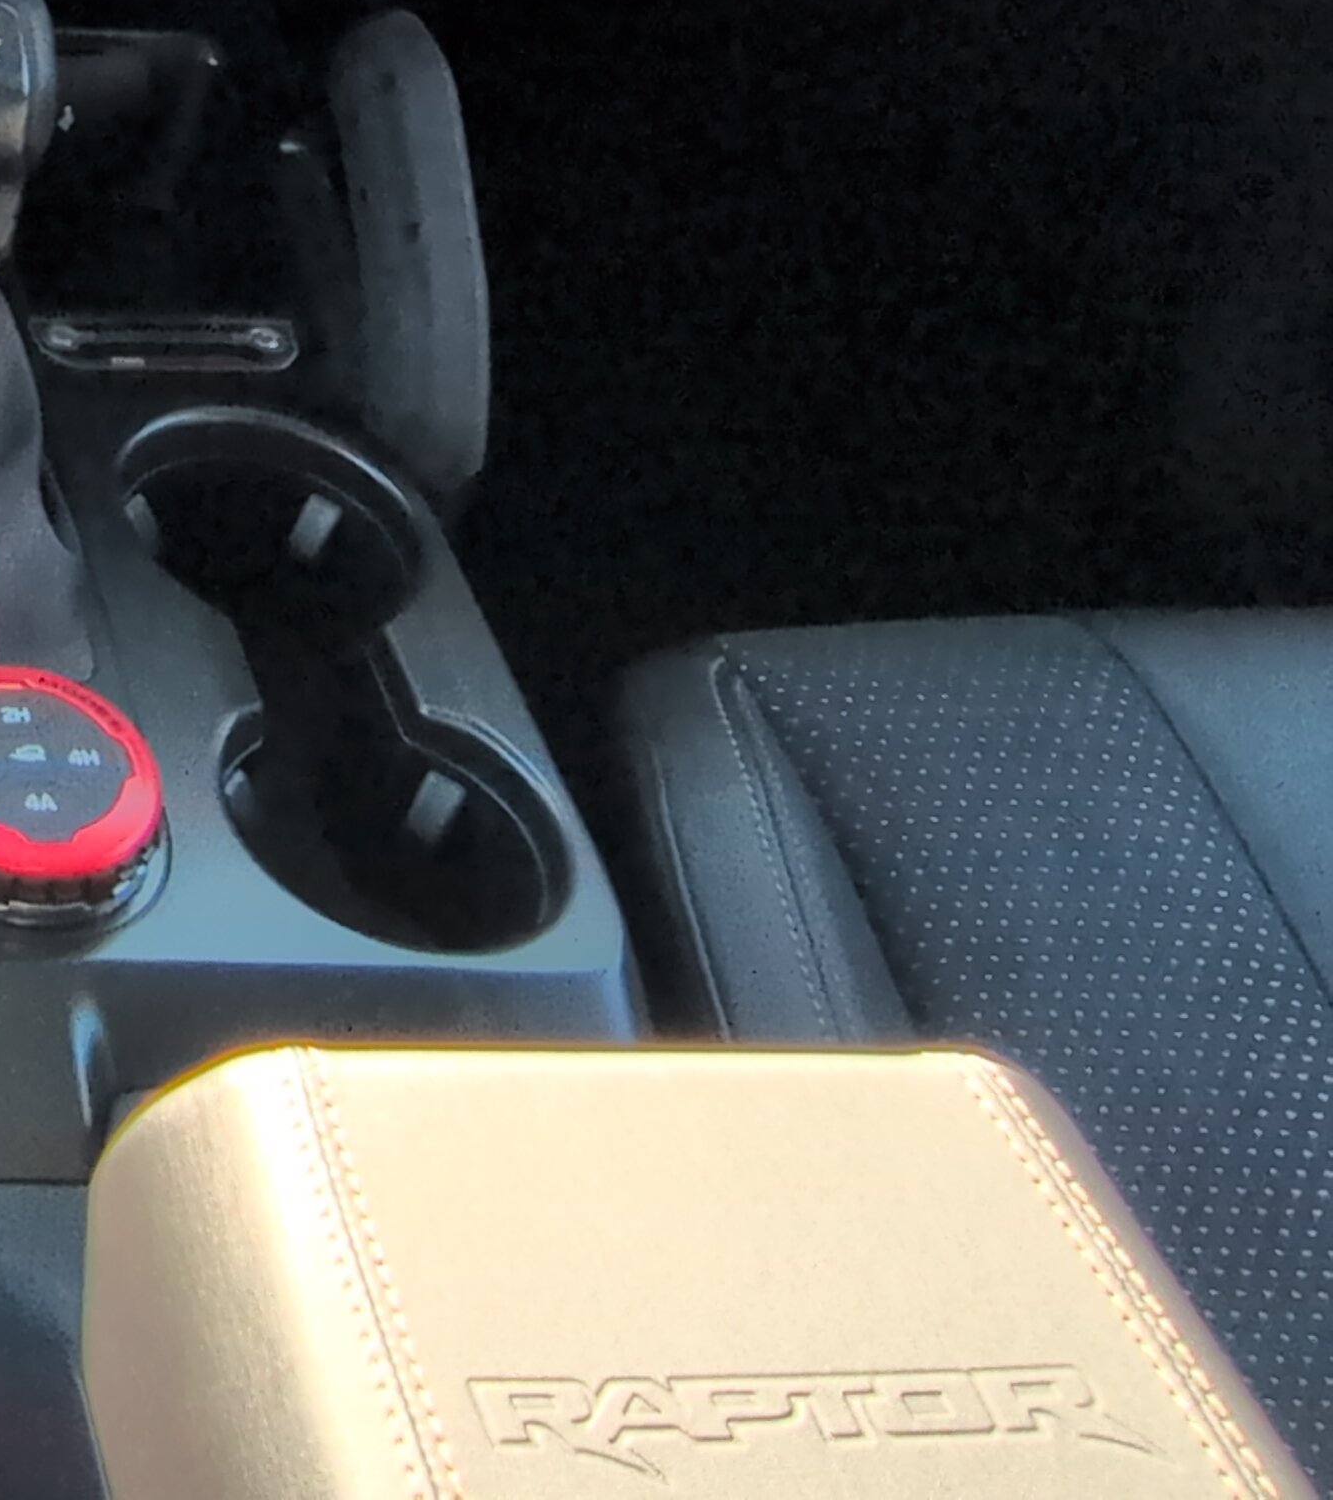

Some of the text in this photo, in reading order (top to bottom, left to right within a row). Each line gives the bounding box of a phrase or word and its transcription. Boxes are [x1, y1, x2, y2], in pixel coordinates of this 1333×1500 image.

[0, 706, 32, 724] 2H
[68, 749, 101, 767] 4H
[465, 1364, 1158, 1485] RAPTOR
